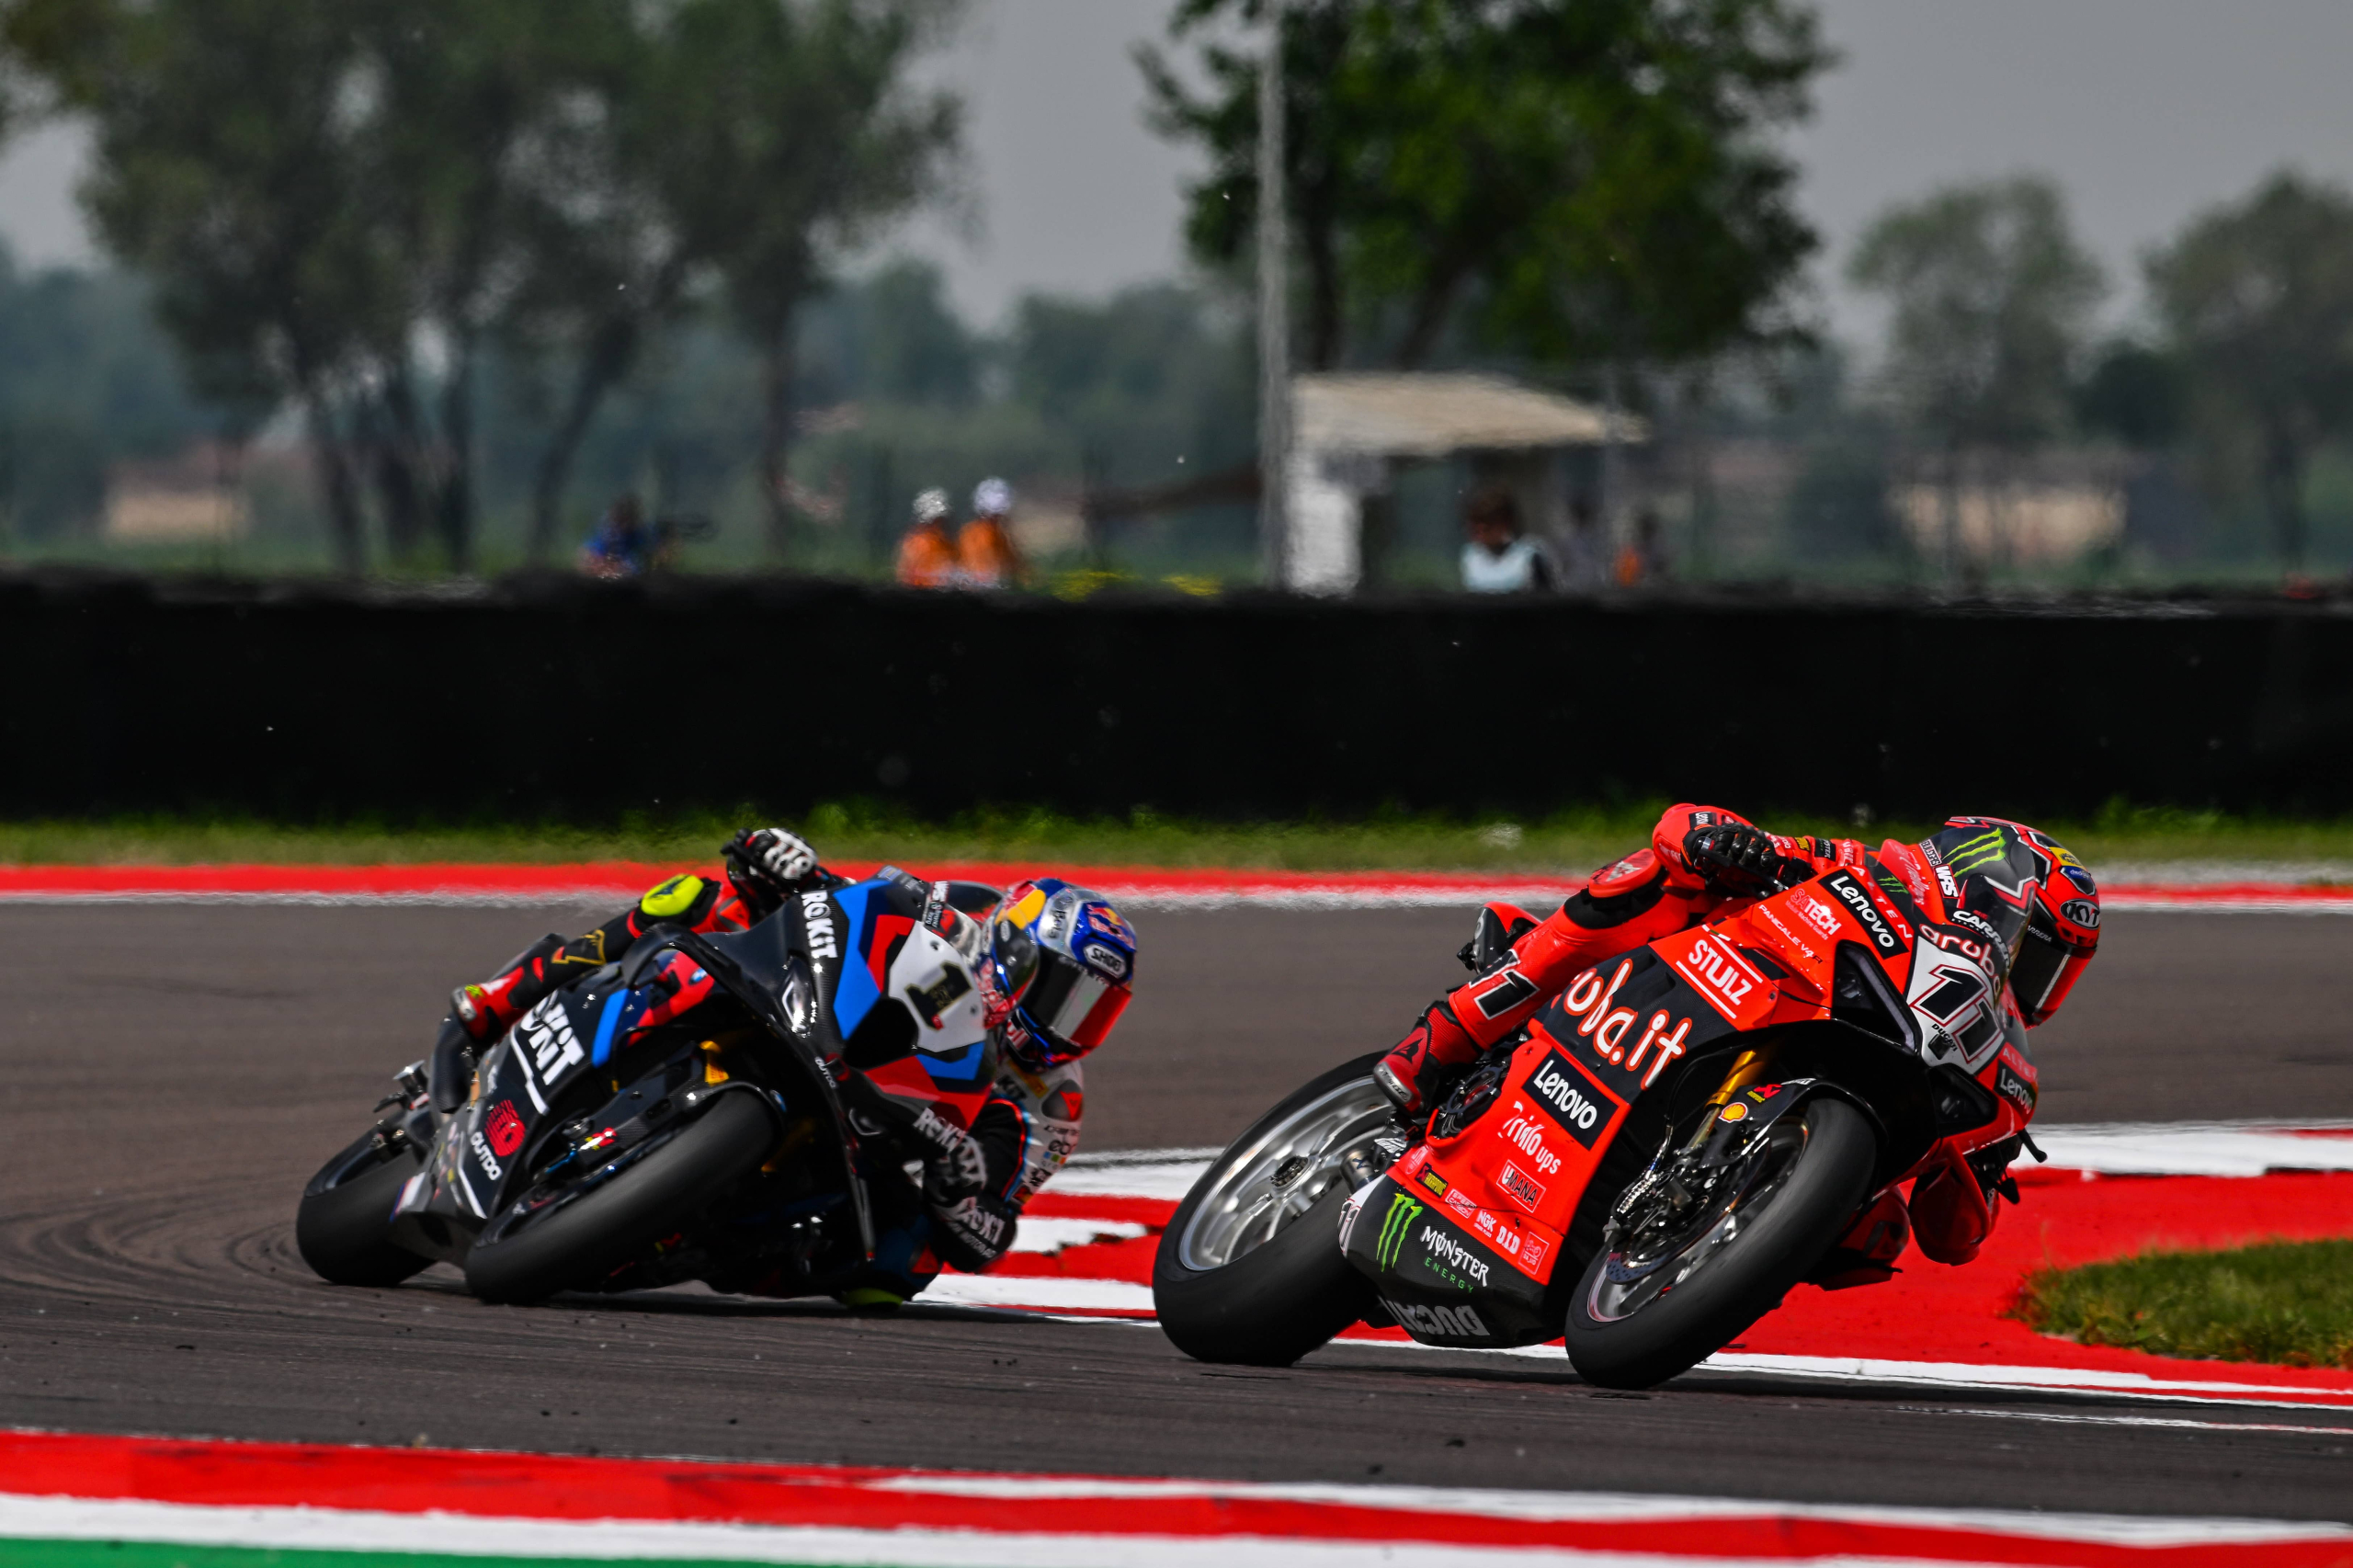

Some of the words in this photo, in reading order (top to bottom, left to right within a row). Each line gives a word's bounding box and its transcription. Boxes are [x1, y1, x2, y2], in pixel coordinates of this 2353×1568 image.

[1758, 904, 1802, 946] PANIGALE
[1790, 888, 1842, 936] SATECH
[1830, 876, 1894, 948] Lenovo
[1919, 923, 2001, 996] aruba
[1952, 910, 2010, 976] CARRER
[904, 961, 973, 1031] 1
[1688, 939, 1753, 1006] STULZ
[1563, 959, 1692, 1091] uba.it
[1909, 964, 2005, 1064] 11
[1931, 1023, 1958, 1051] DUCATI
[1533, 1060, 1597, 1130] Lenovo
[2000, 1068, 2034, 1115] Lenovo
[470, 1131, 503, 1181] OUTDO
[1536, 1146, 1562, 1174] ups
[1501, 1165, 1539, 1207] UMANA
[1476, 1210, 1497, 1233] NGK
[1425, 1256, 1474, 1293] ENERGY
